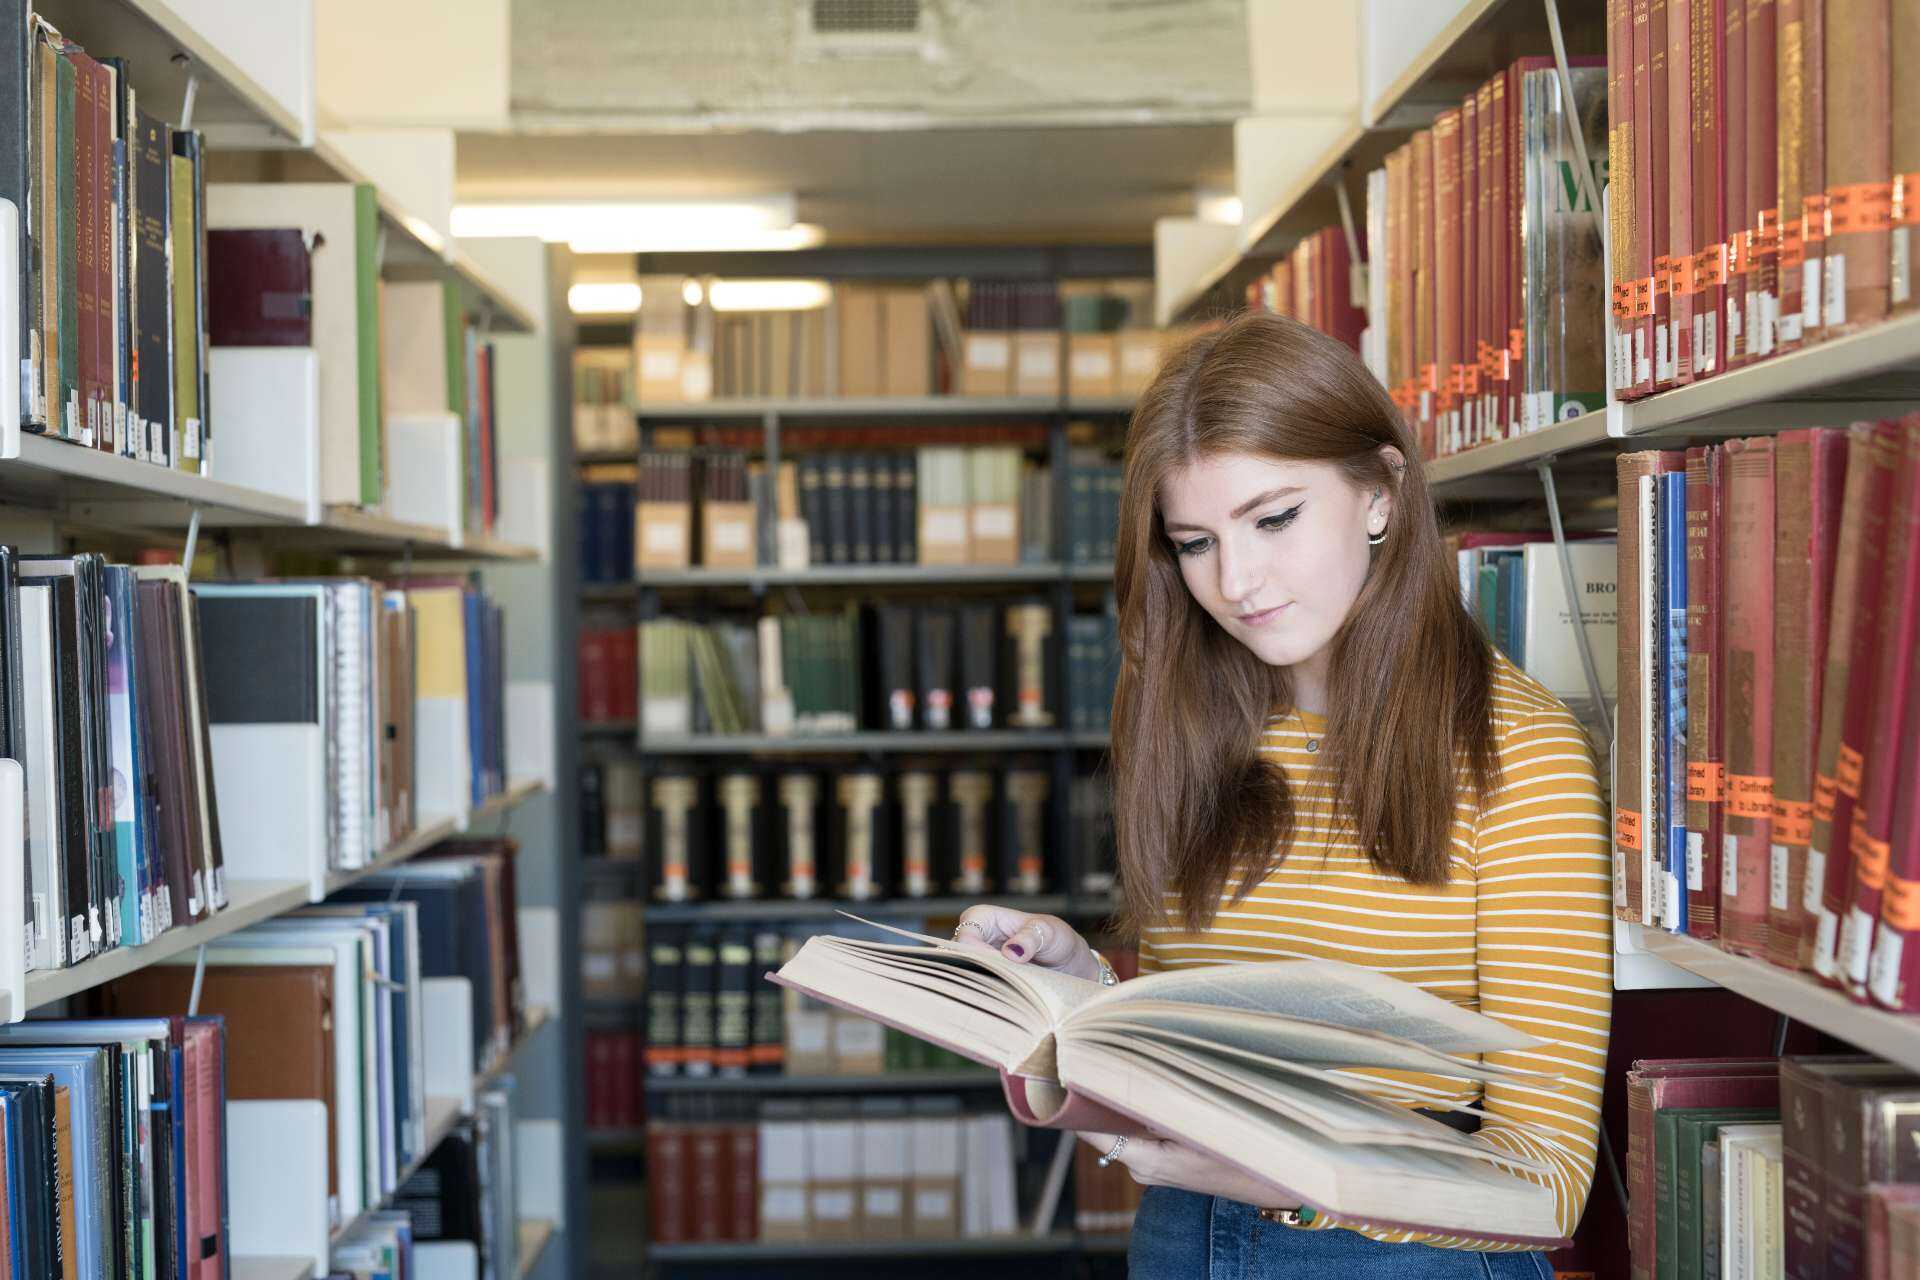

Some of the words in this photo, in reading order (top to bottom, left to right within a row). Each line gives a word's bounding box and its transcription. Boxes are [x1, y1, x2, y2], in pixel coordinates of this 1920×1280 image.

[1648, 477, 1657, 624] ARCHAEOLOGY
[1586, 582, 1616, 594] BRO
[1740, 780, 1773, 794] Confined
